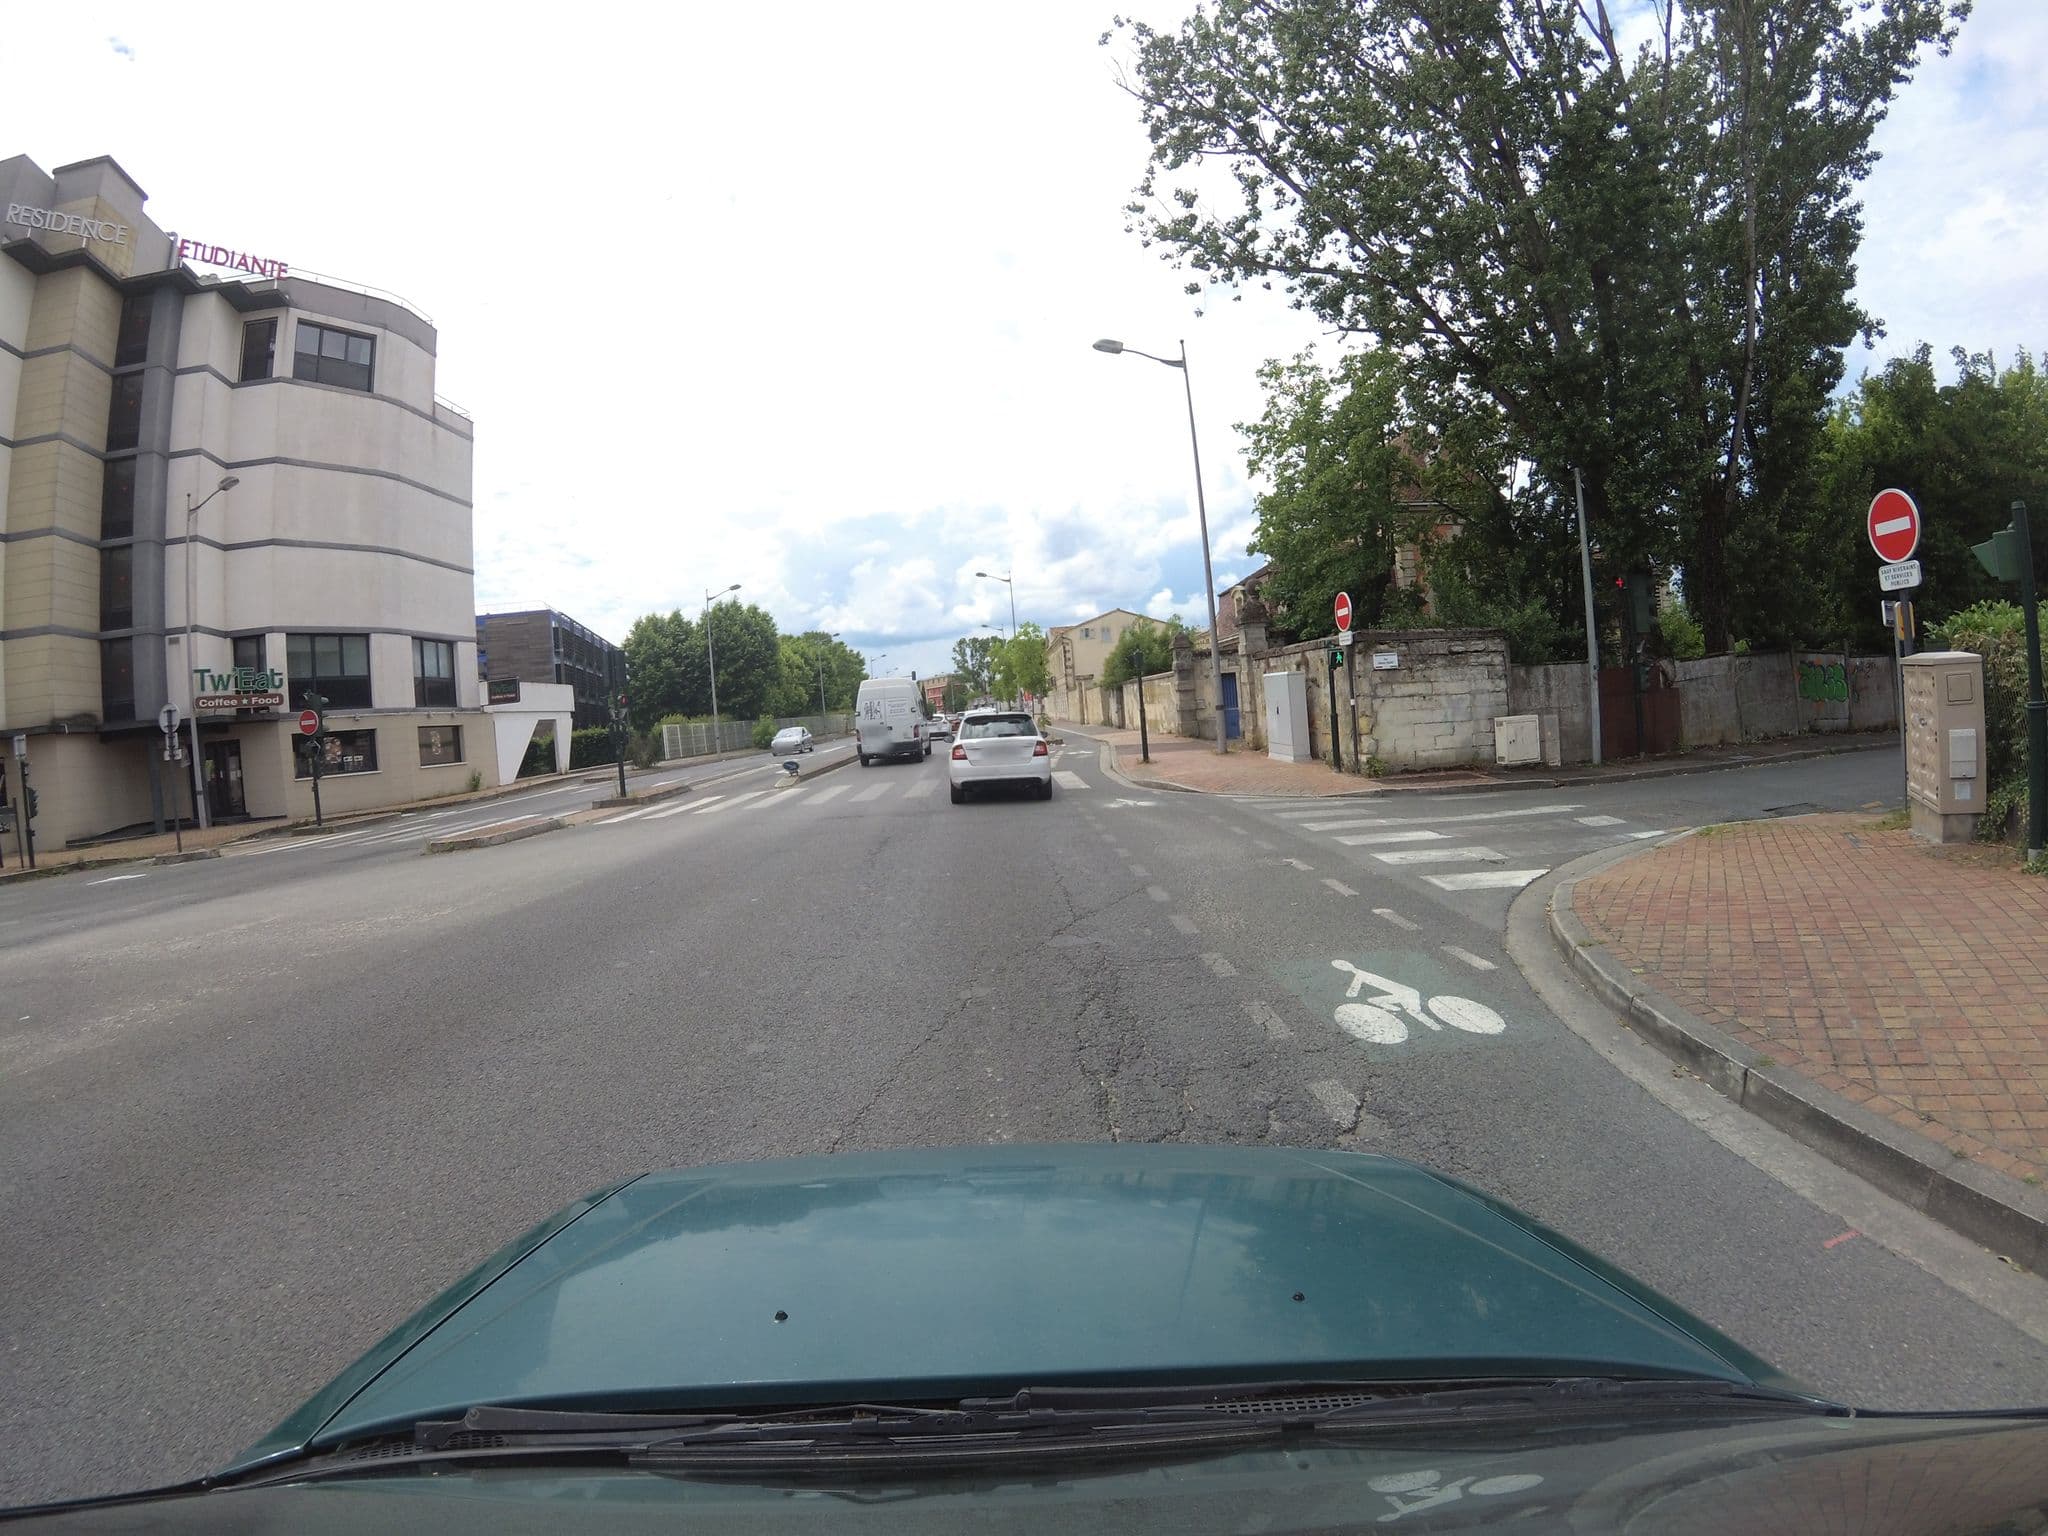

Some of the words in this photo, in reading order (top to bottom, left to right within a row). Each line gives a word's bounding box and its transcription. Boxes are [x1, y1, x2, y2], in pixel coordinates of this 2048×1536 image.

[5, 202, 129, 246] RESIDENCE
[178, 238, 289, 282] ETUDIANTE
[198, 697, 238, 708] Coffee
[251, 696, 279, 705] Food
